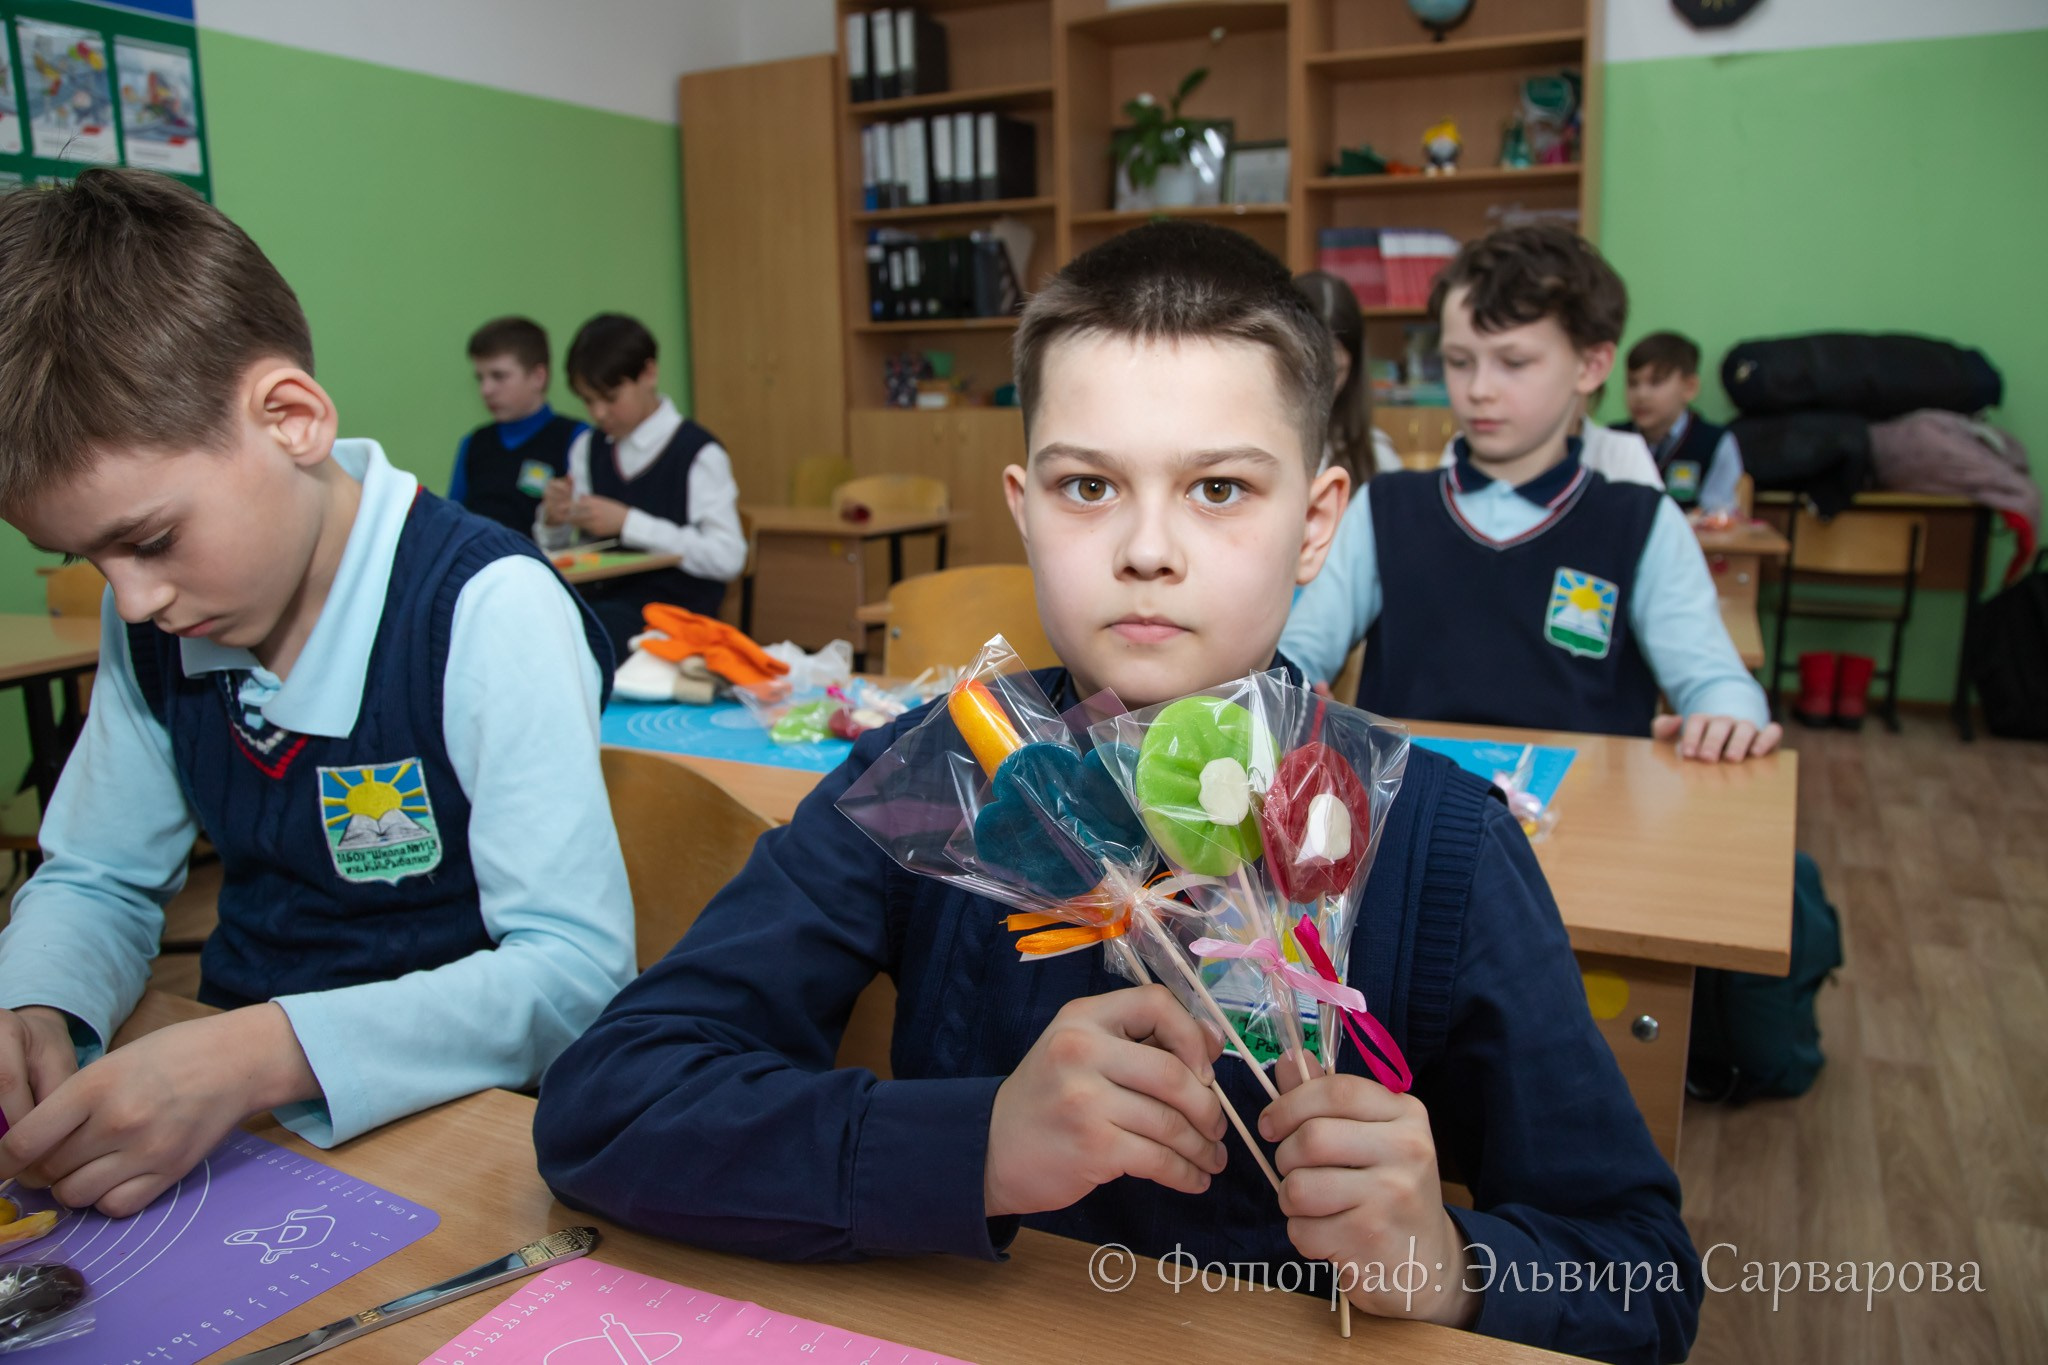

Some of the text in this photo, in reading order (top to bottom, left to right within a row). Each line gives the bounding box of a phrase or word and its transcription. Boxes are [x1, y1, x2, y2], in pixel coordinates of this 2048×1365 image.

[645, 1299, 662, 1309] 13
[465, 1346, 484, 1358] 21
[484, 1331, 504, 1344] 22
[502, 1318, 521, 1330] 23
[520, 1304, 539, 1317] 24
[537, 1291, 555, 1304] 25
[554, 1279, 572, 1291] 26
[695, 1313, 711, 1323] 12
[800, 1343, 817, 1354] 10
